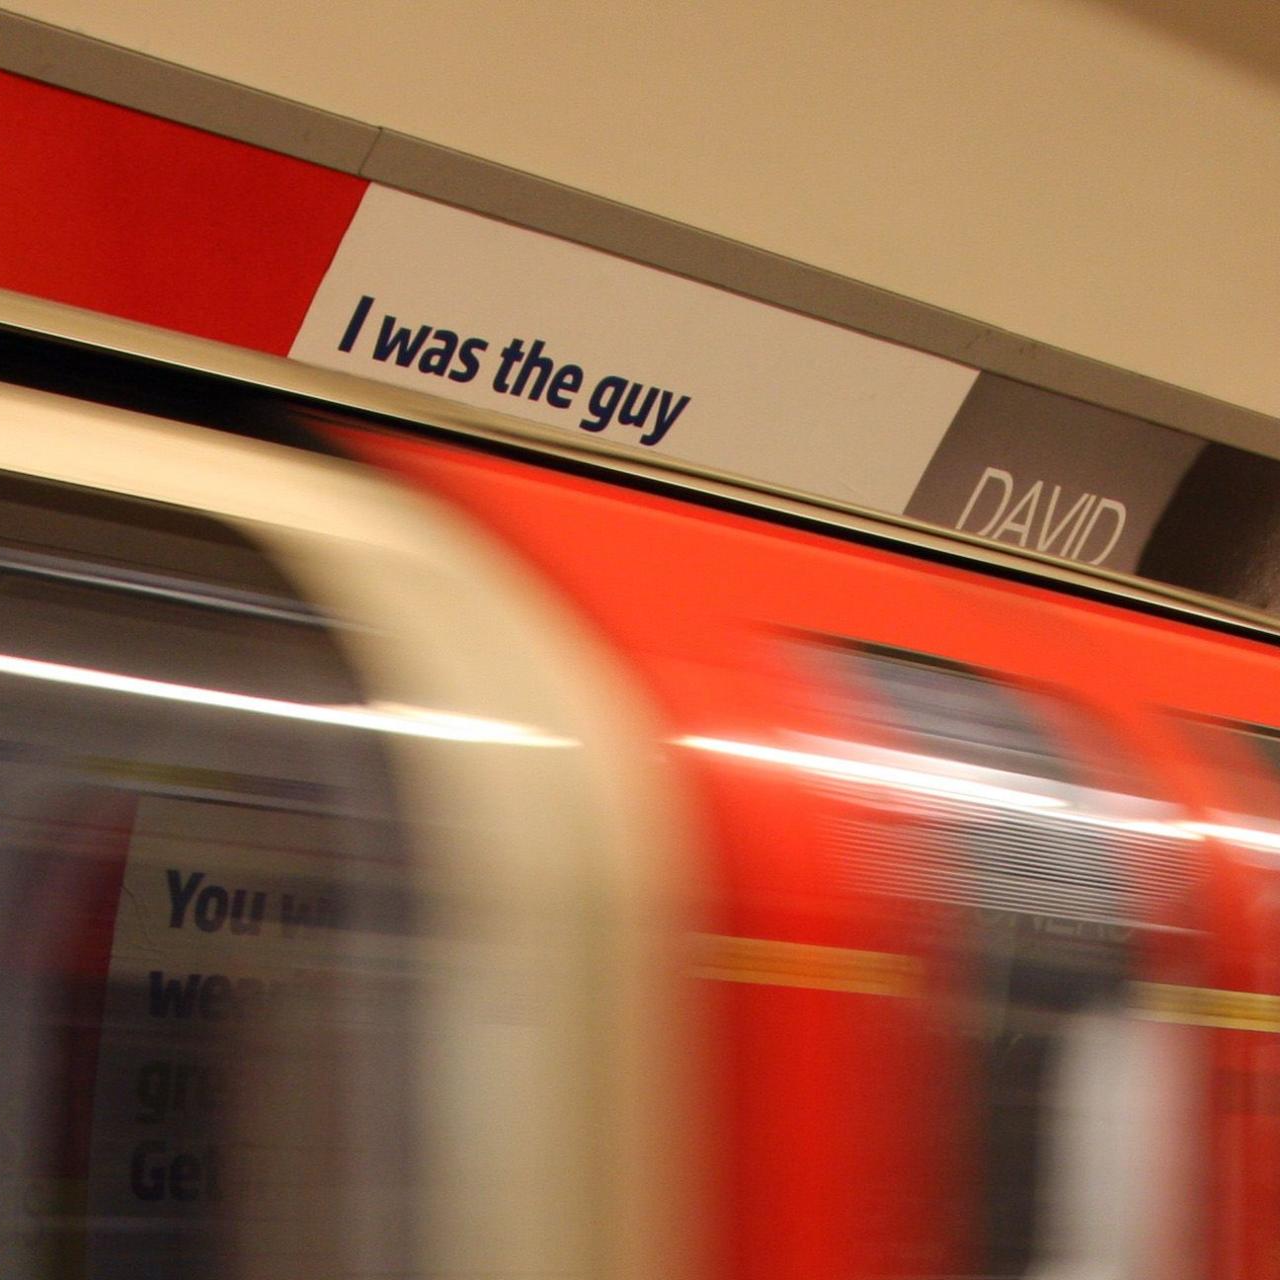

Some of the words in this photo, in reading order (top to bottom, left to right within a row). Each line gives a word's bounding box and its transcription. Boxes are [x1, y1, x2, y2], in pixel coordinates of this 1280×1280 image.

[338, 295, 375, 352] I
[372, 315, 488, 383] was
[492, 339, 584, 408] the
[579, 374, 692, 446] guy
[955, 466, 1127, 566] DAVID
[165, 868, 267, 935] You
